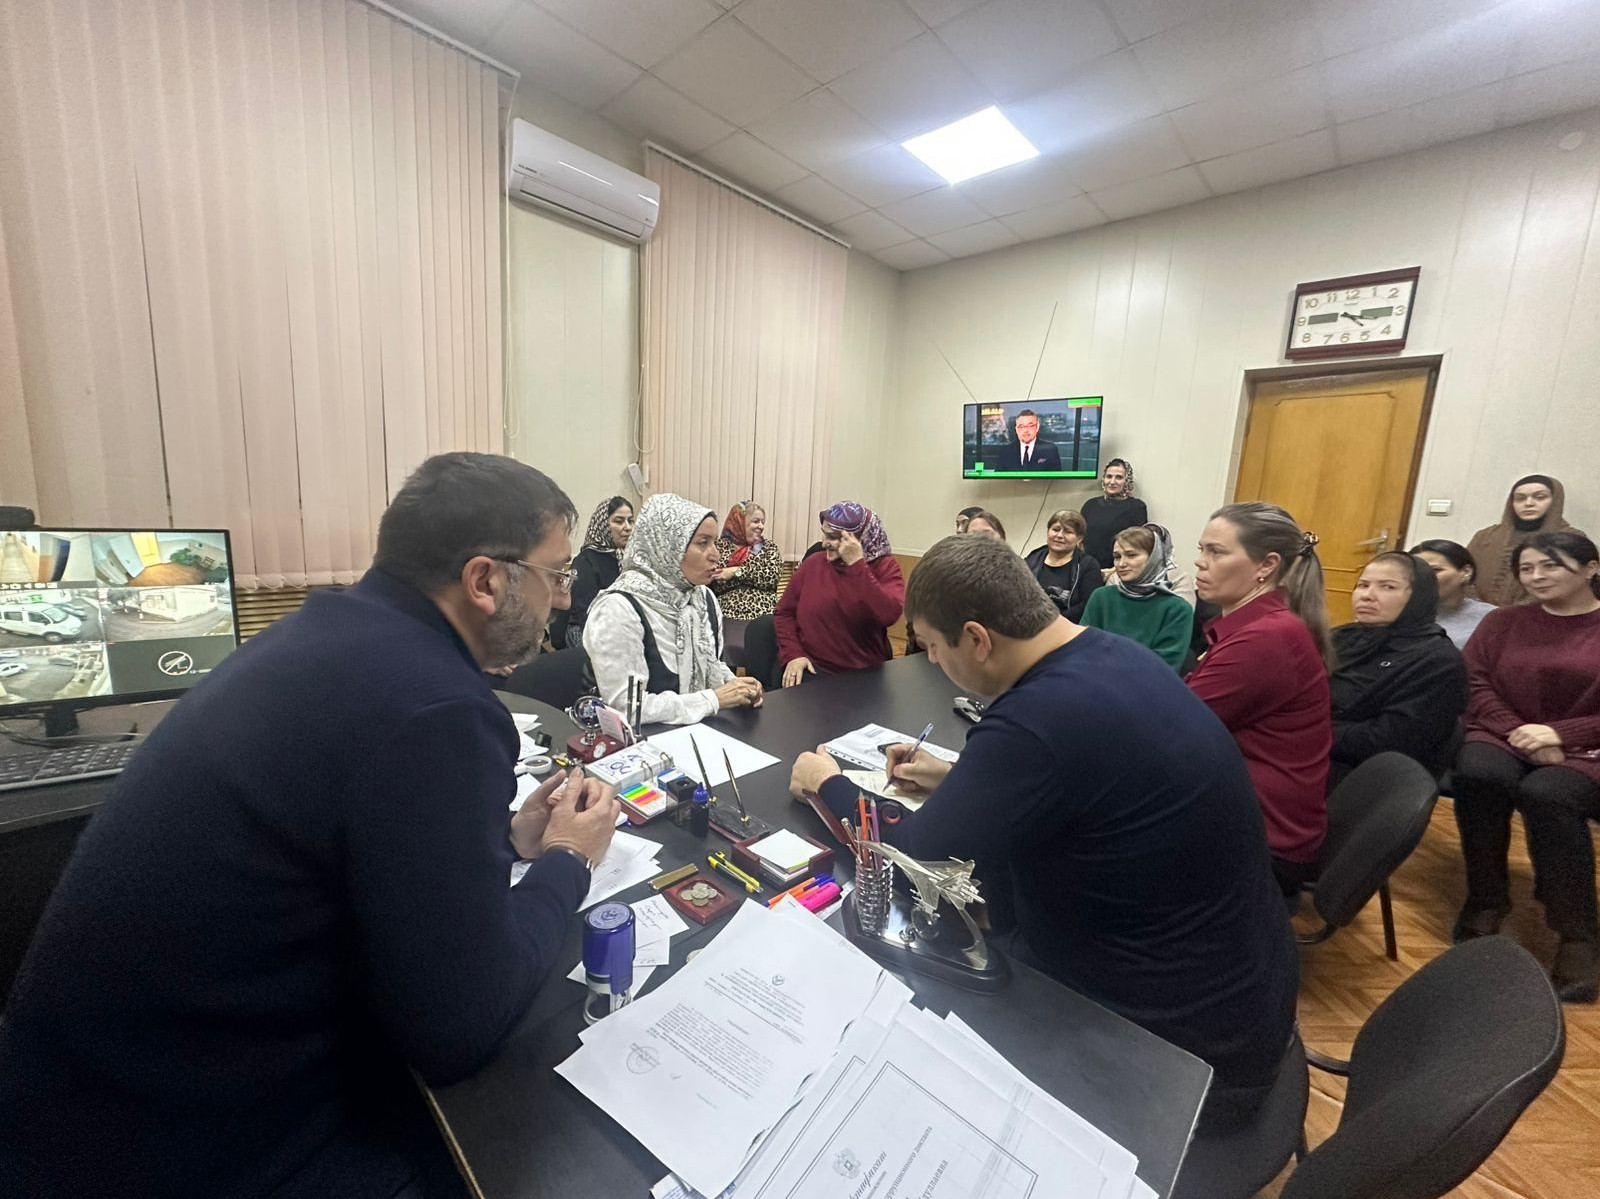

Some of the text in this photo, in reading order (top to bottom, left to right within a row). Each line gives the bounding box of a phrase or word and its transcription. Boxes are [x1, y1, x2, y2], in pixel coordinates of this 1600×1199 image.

[1327, 292, 1338, 303] 11
[1345, 289, 1360, 301] 12
[1371, 287, 1376, 297] 1
[1388, 288, 1399, 299] 2
[1305, 298, 1319, 309] 10
[1394, 305, 1405, 316] 3
[1297, 316, 1307, 327] 9
[1360, 330, 1370, 341] 5
[1380, 324, 1392, 336] 4
[1302, 332, 1312, 343] 8
[1323, 334, 1333, 345] 7
[1339, 333, 1350, 343] 6
[848, 1150, 887, 1199] тификат
